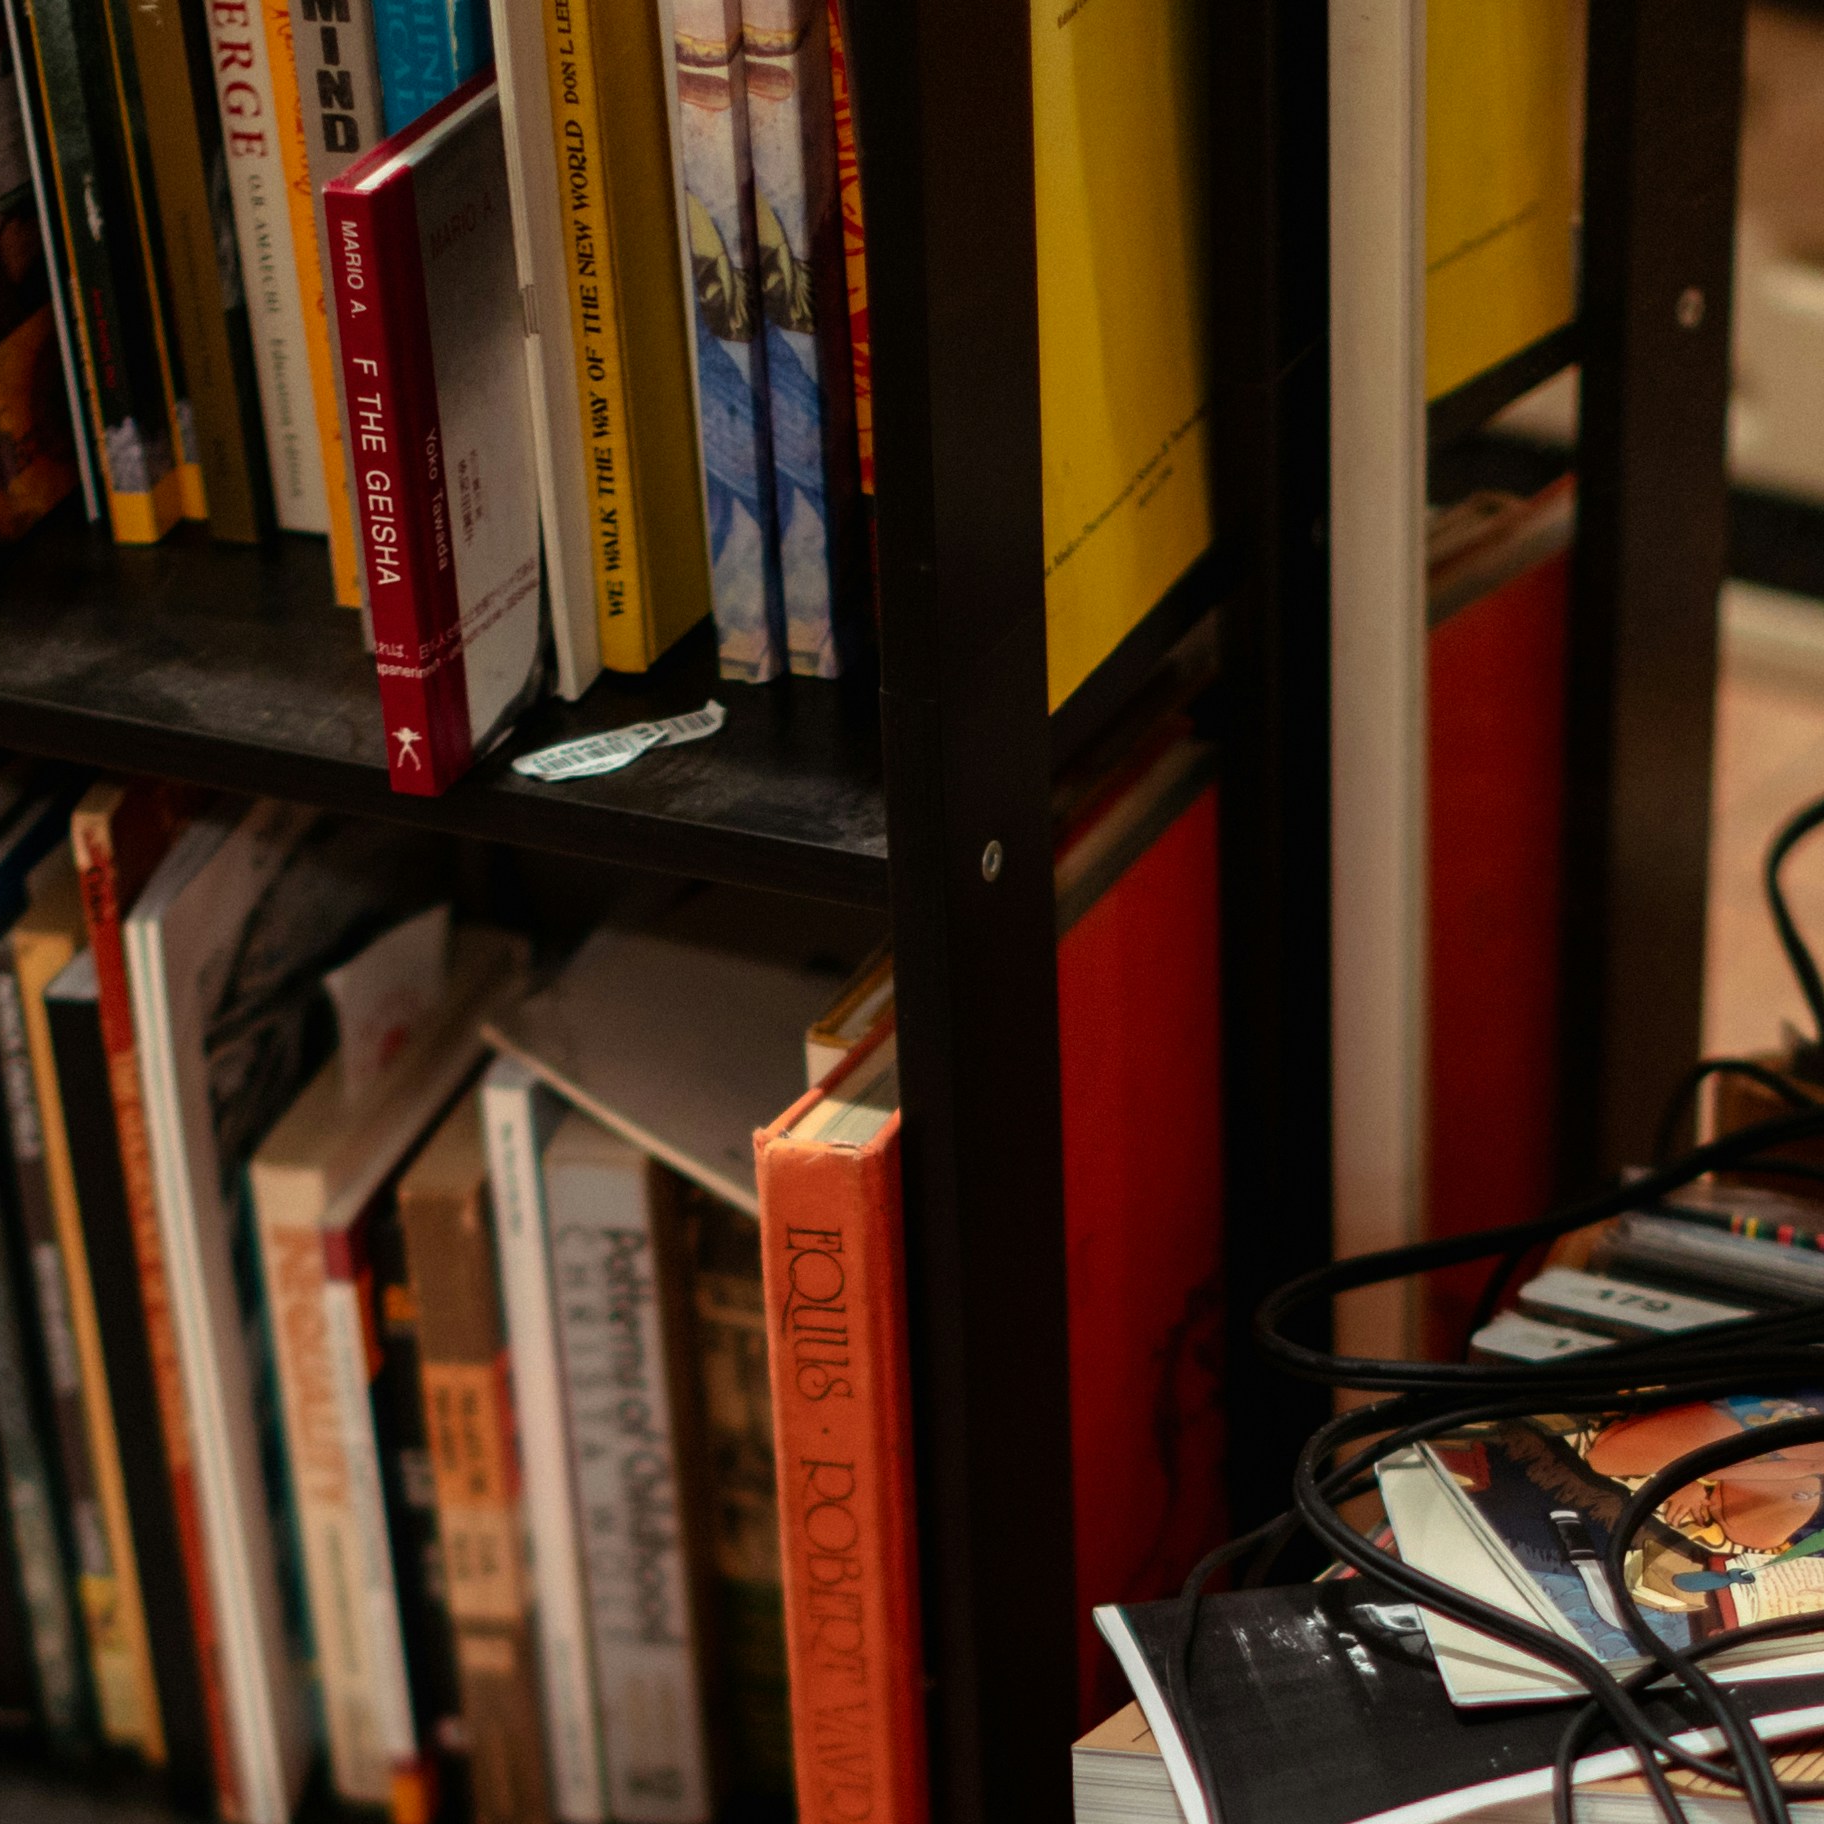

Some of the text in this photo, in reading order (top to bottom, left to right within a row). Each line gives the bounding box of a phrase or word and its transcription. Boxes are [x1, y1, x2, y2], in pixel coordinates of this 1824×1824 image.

[560, 61, 580, 105] DON
[565, 119, 591, 212] WORLD
[576, 220, 596, 278] NEW
[580, 285, 602, 337] THE
[585, 346, 606, 382] OF
[340, 219, 402, 586] MARIO A. F THE GEISHA
[589, 391, 611, 439] WAY
[426, 427, 448, 571] Yoko Tawada
[595, 446, 615, 498] THE
[600, 507, 622, 572] WALK
[606, 579, 625, 618] WE
[781, 1225, 855, 1401] EQUUS
[800, 1457, 868, 1686] ROBERT
